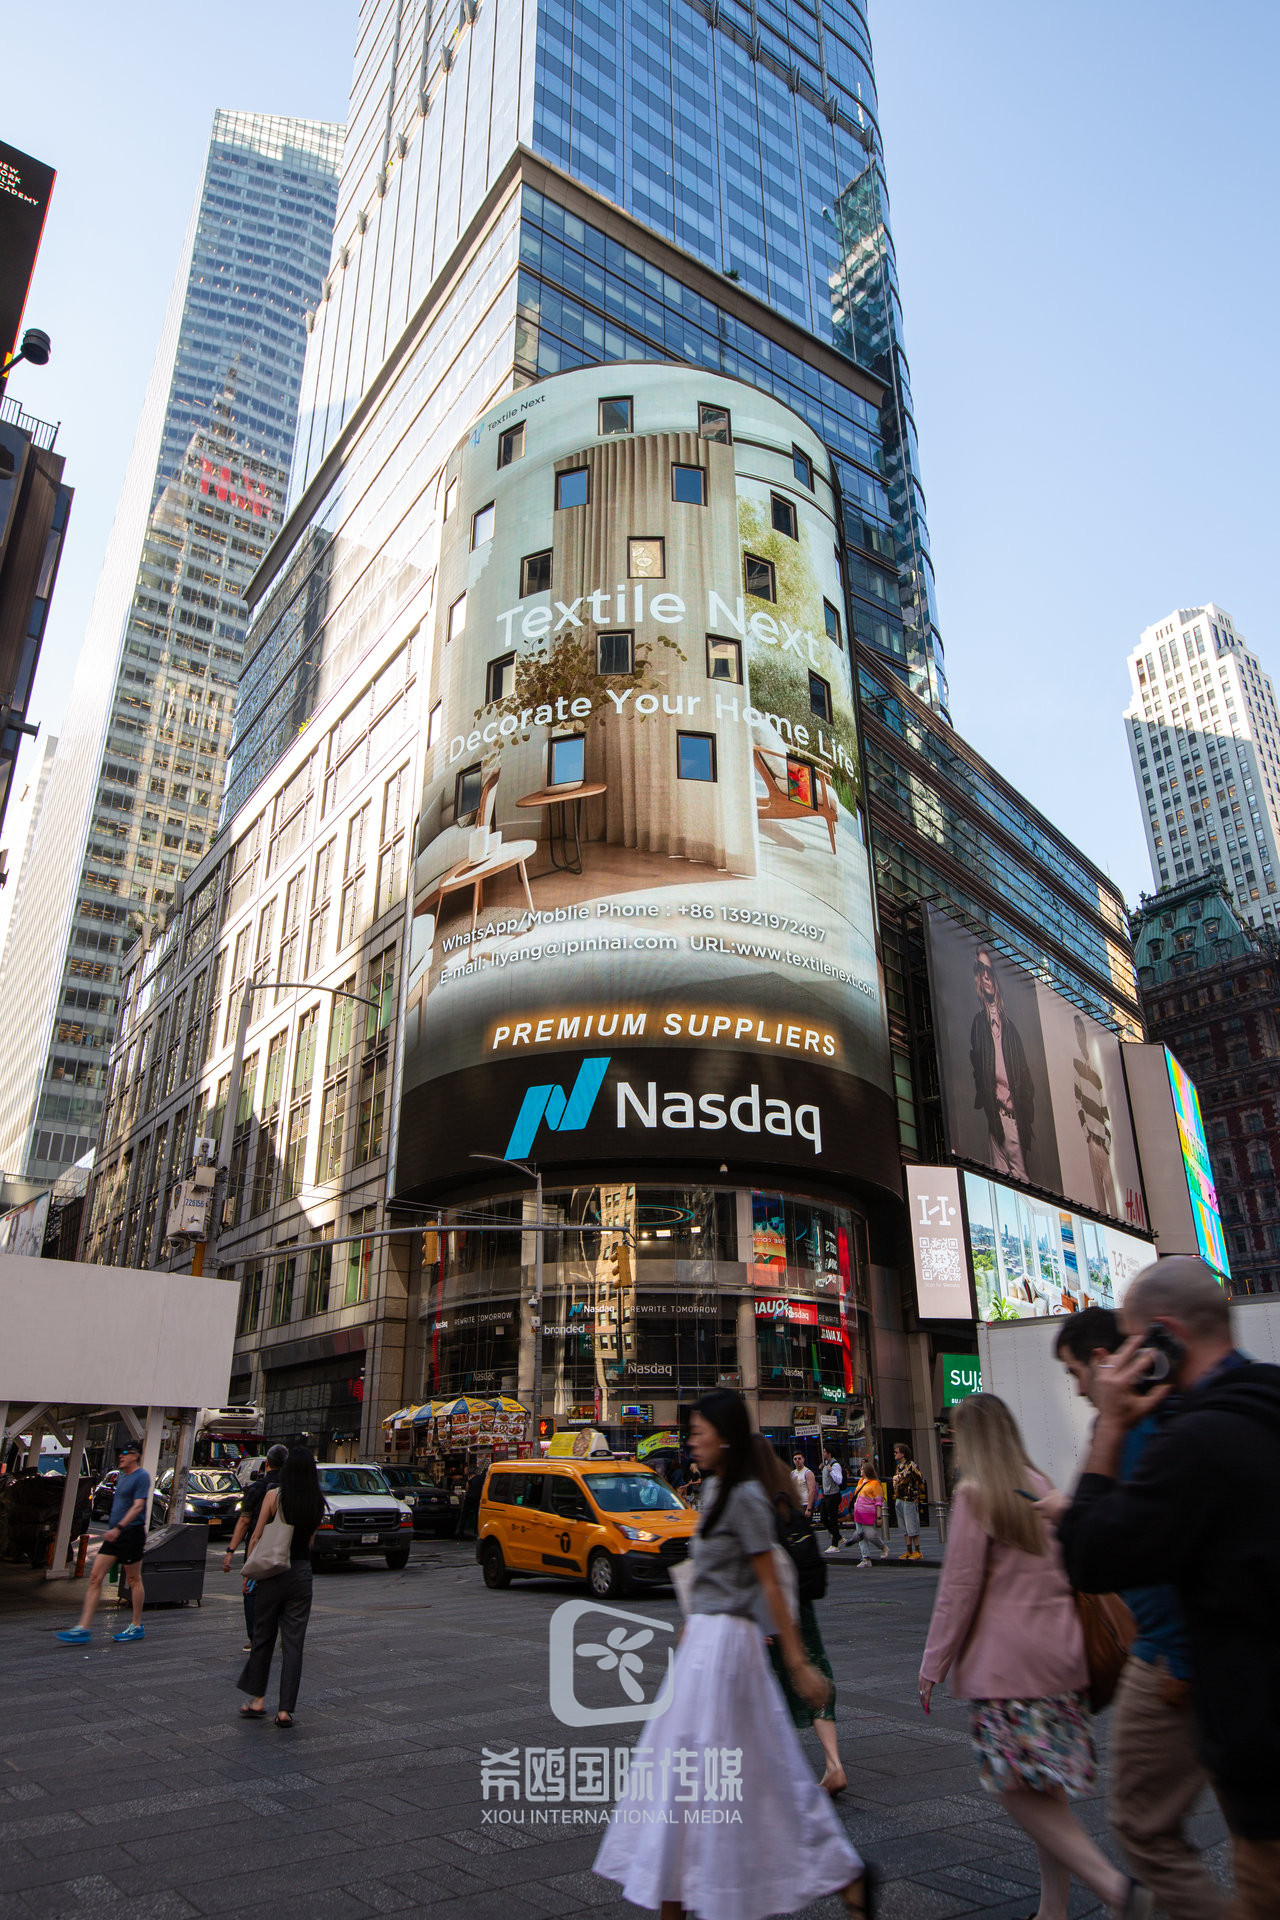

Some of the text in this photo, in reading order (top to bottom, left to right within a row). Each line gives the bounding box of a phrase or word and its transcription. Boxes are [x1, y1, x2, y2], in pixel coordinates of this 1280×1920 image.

[0, 169, 21, 184] ORK
[0, 181, 39, 206] CADEMY
[487, 395, 546, 432] Textile Next
[496, 583, 822, 669] Textile Next
[448, 688, 859, 784] Decorate Your Home Life.
[442, 905, 590, 953] WhatsApp/Moblie
[596, 903, 660, 918] Phone
[678, 903, 715, 920] +86
[720, 906, 826, 943] 13921972497
[439, 935, 876, 1000] E-mail: liyang@ipinhai.com URL:www.textilenext.com
[492, 1013, 836, 1057] PREMIUM SUPPLIERS
[616, 1081, 823, 1155] Nasdaq
[477, 1311, 513, 1323] TOMORROW
[583, 1304, 615, 1314] Nasdaq
[630, 1305, 718, 1314] REWRITE TOMORROW
[627, 1362, 673, 1377] Nasdaq
